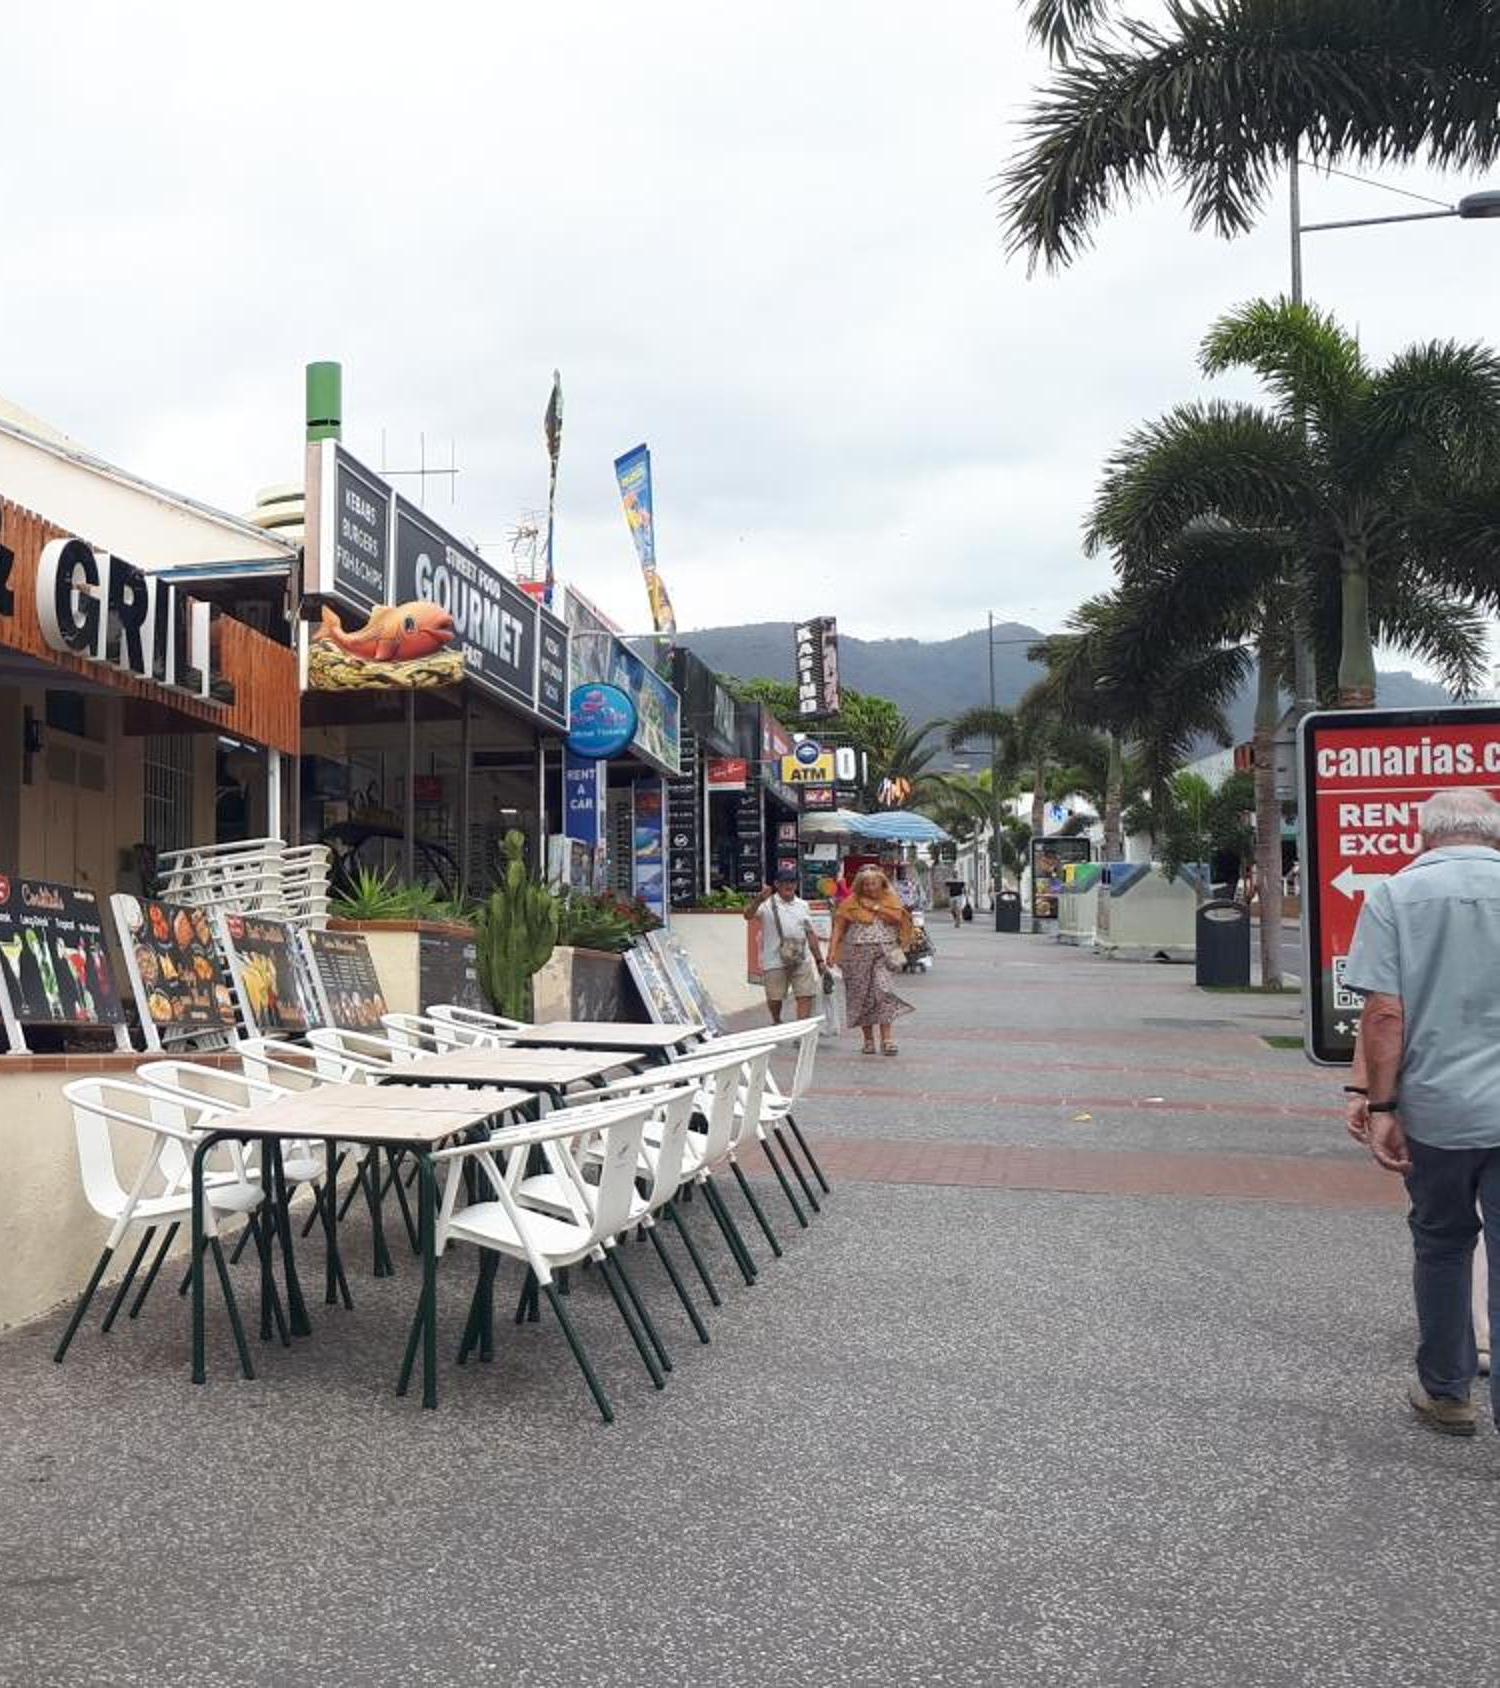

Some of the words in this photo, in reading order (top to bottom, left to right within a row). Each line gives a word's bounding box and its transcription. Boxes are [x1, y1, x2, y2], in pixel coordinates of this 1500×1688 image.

[345, 488, 378, 528] KEBABS
[342, 517, 380, 558] BURGERS
[445, 545, 477, 583] STREET
[478, 568, 501, 600] FOOD
[36, 538, 236, 706] GRILL
[414, 552, 524, 670] GOURMET
[567, 768, 597, 781] RENT
[576, 783, 586, 795] A
[790, 768, 827, 781] ATM
[569, 797, 593, 809] CAR
[1338, 803, 1424, 828] RENT
